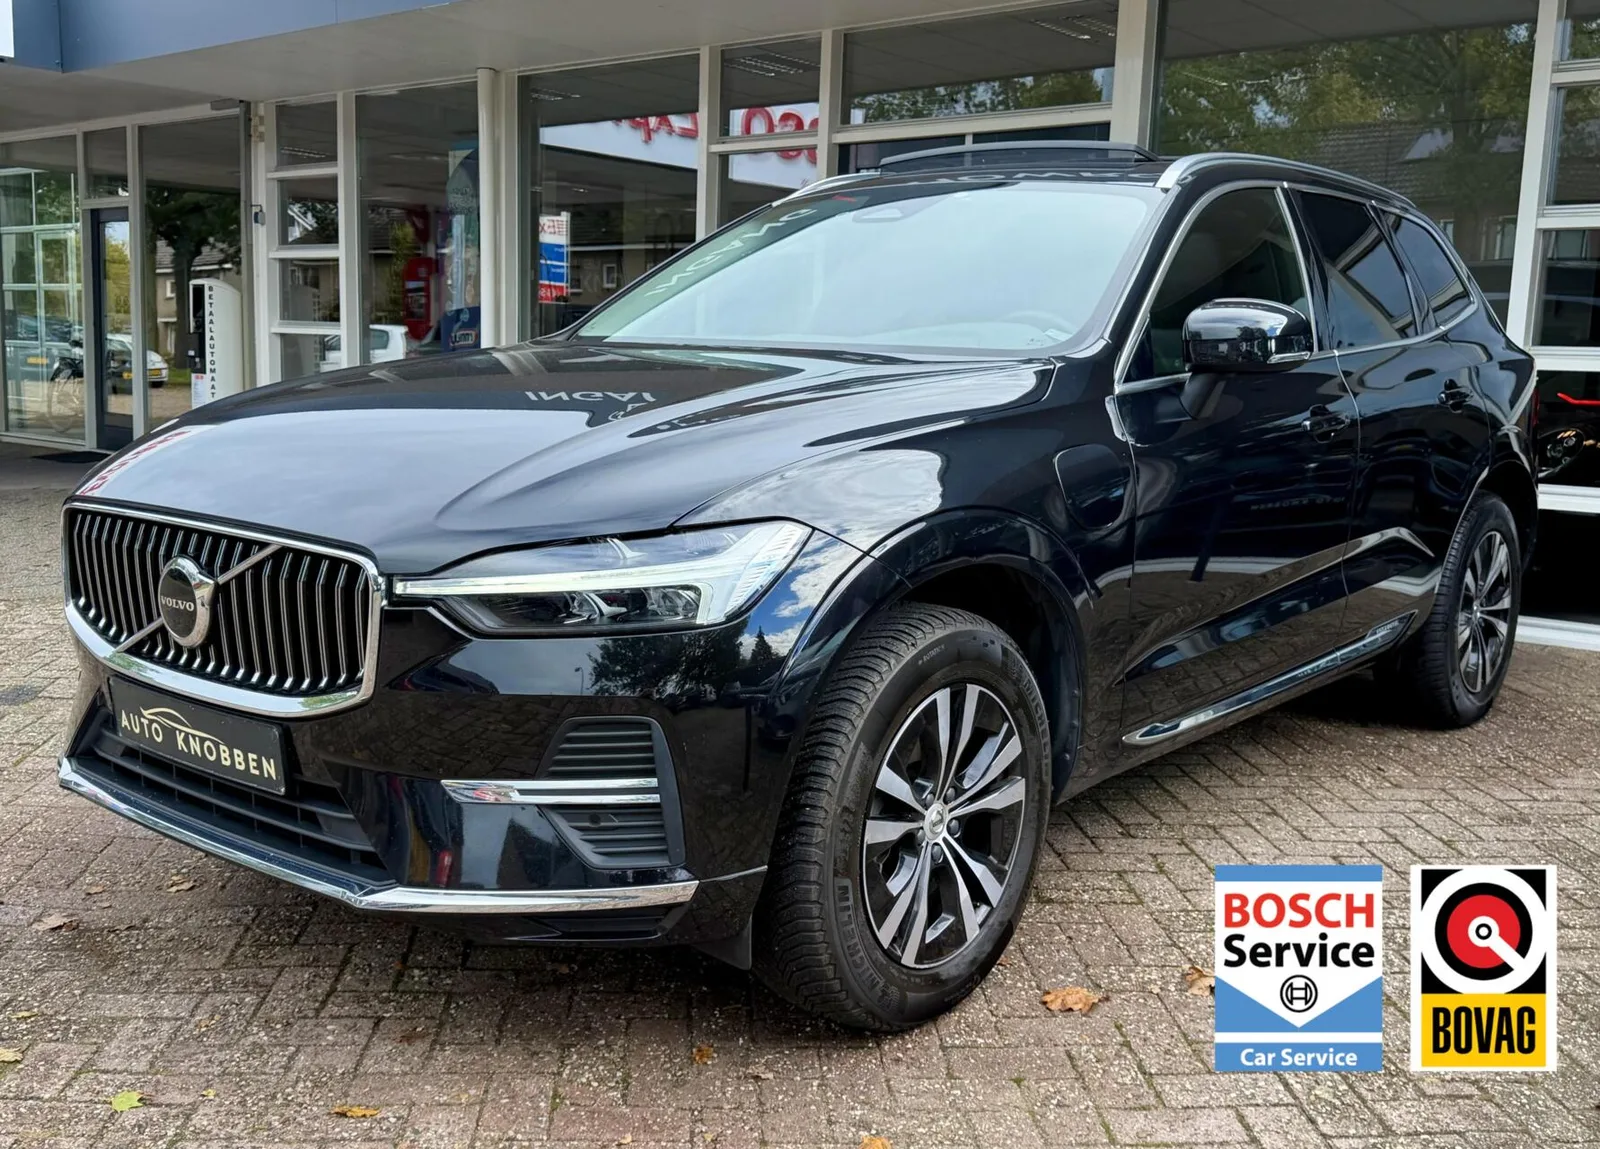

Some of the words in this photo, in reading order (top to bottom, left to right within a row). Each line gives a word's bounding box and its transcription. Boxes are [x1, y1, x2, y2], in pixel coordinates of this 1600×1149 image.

[207, 285, 217, 399] BETAALAUTOMAAT
[161, 595, 195, 612] VOLVO
[121, 709, 164, 744] AUTO
[175, 729, 277, 782] KNOBBEN
